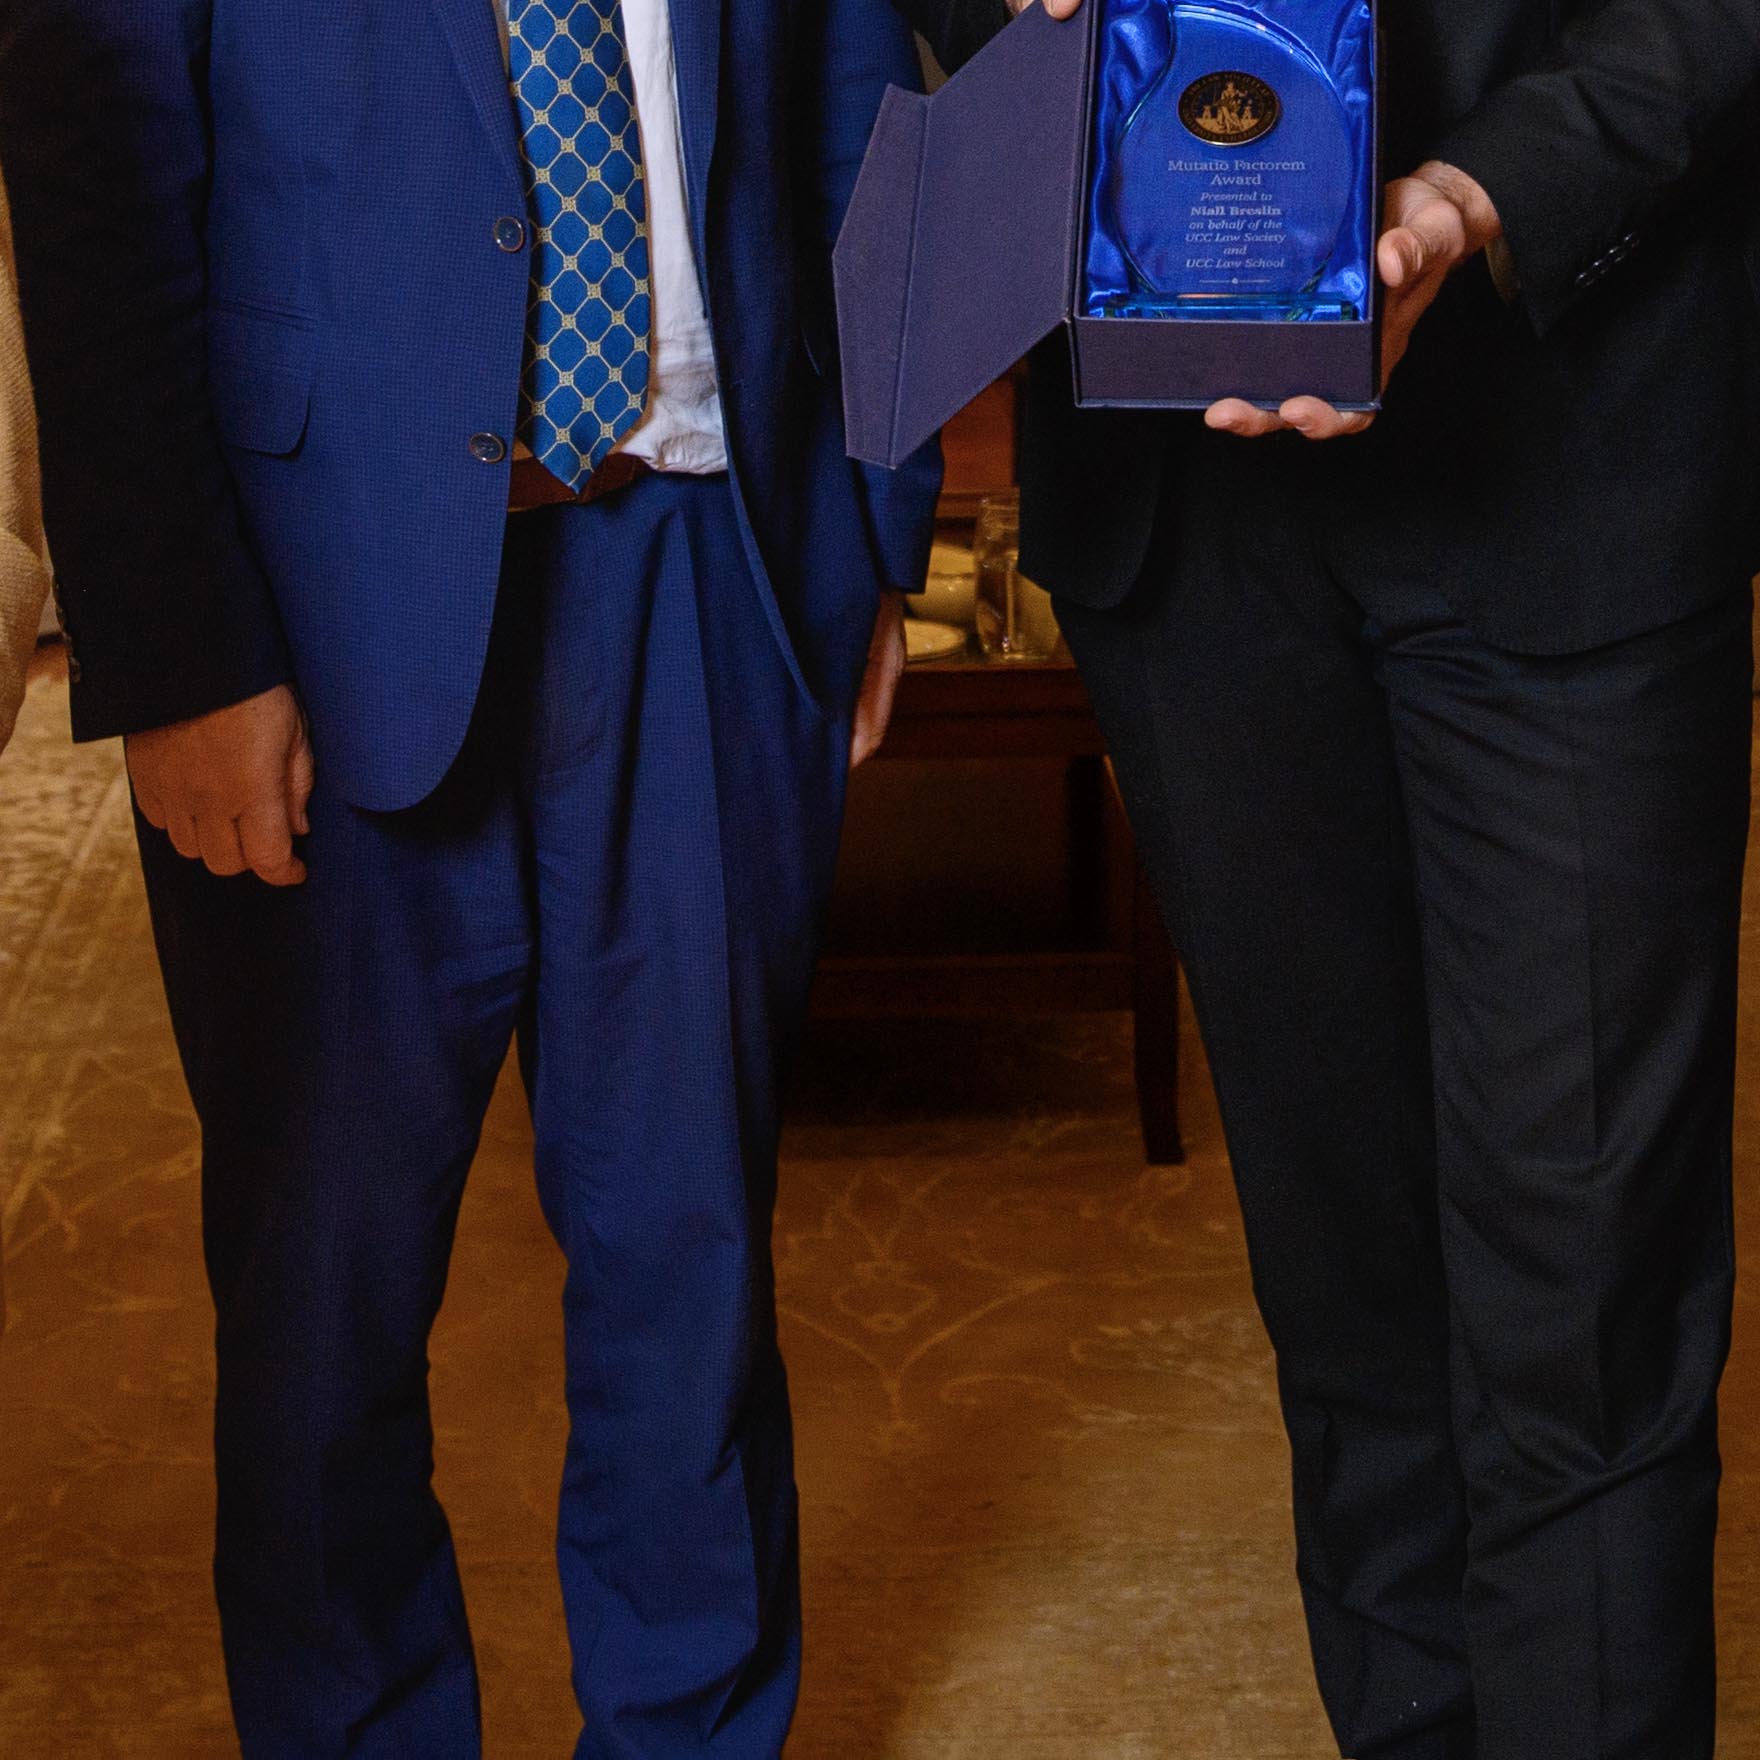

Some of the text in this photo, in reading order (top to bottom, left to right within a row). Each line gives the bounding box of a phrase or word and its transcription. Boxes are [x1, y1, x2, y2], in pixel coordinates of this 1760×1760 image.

[1168, 160, 1306, 171] Mutatio Factorem
[1211, 174, 1261, 185] Award
[1200, 192, 1272, 201] Presented to
[1191, 206, 1282, 216] Niall Breslin
[1189, 220, 1282, 230] on behalf of the
[1185, 233, 1286, 243] UCC Law Society
[1223, 246, 1247, 255] and
[1186, 258, 1285, 268] UCC Law School
